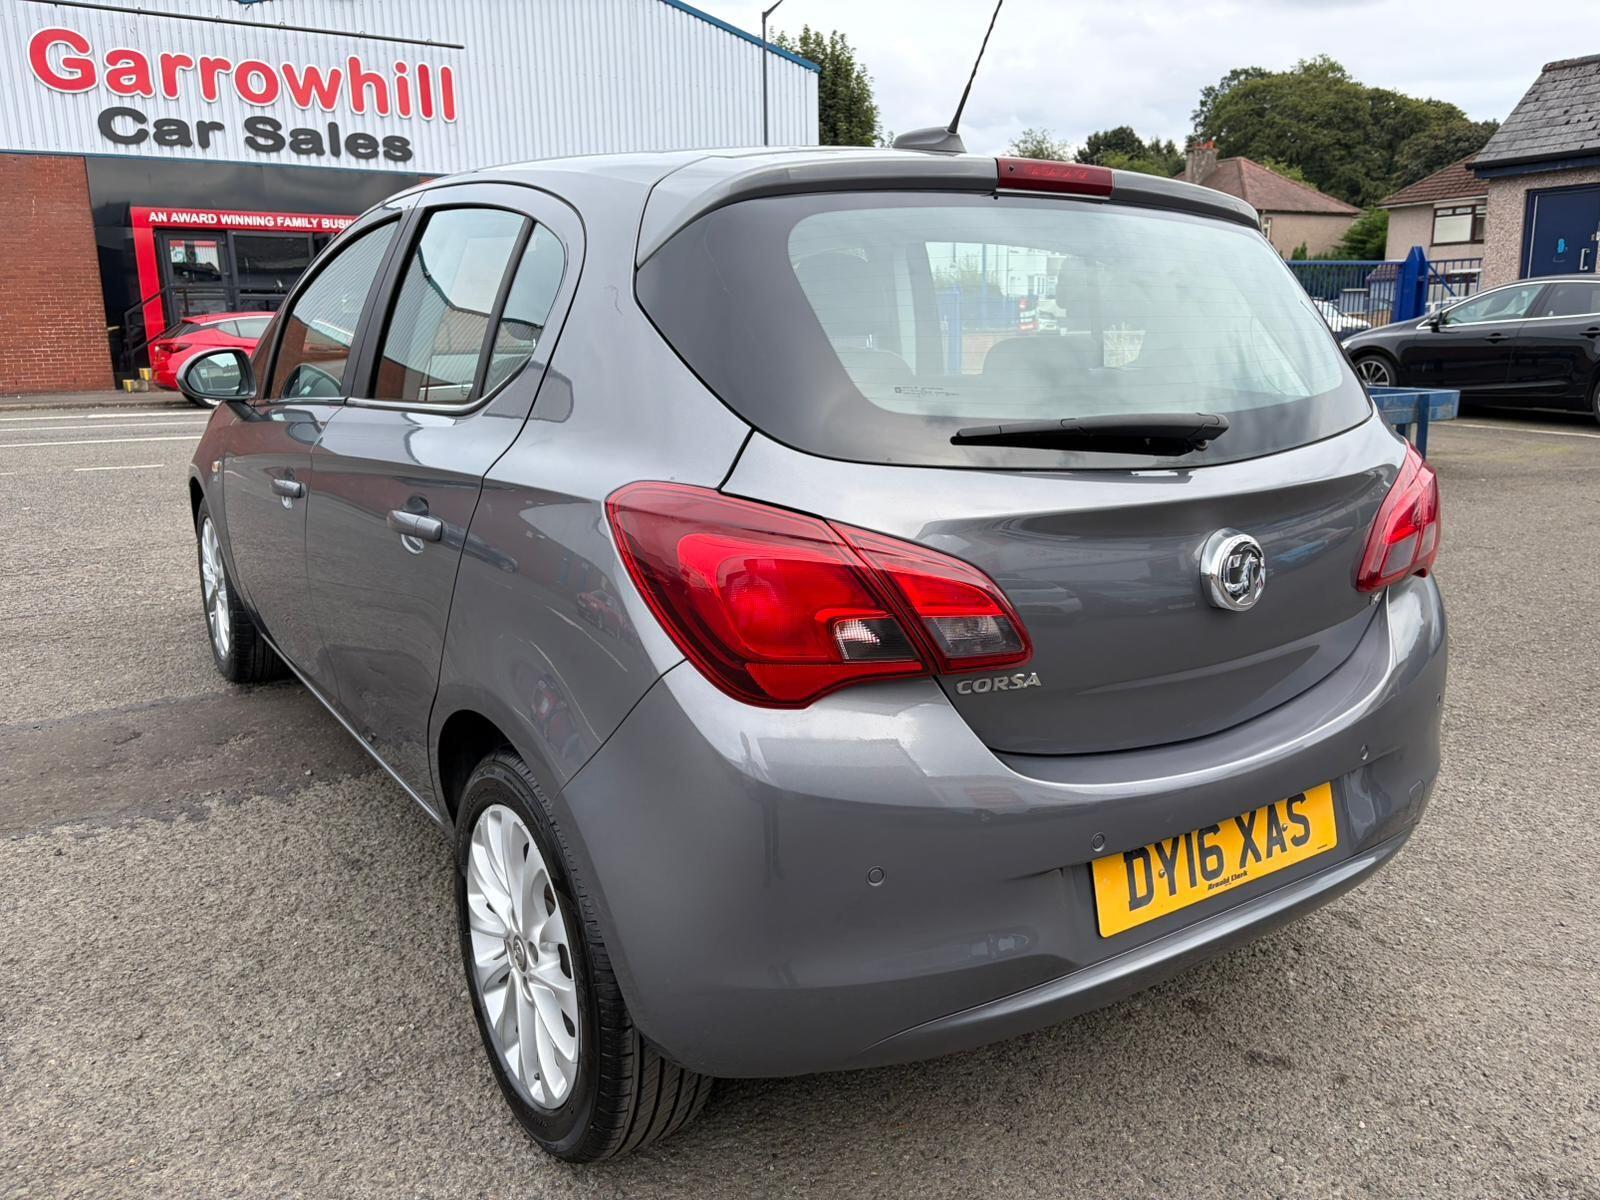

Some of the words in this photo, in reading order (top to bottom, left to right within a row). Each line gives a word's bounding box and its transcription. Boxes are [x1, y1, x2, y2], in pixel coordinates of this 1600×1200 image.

[28, 27, 457, 122] Garrowhill
[98, 107, 224, 149] Car
[244, 116, 413, 162] Sales
[149, 212, 167, 222] AN
[170, 212, 217, 224] AWARD
[220, 214, 274, 226] WINNING
[277, 216, 319, 228] FAMILY
[956, 672, 1042, 694] CORSA
[1122, 821, 1225, 912] DY16
[1234, 792, 1311, 870] XAS
